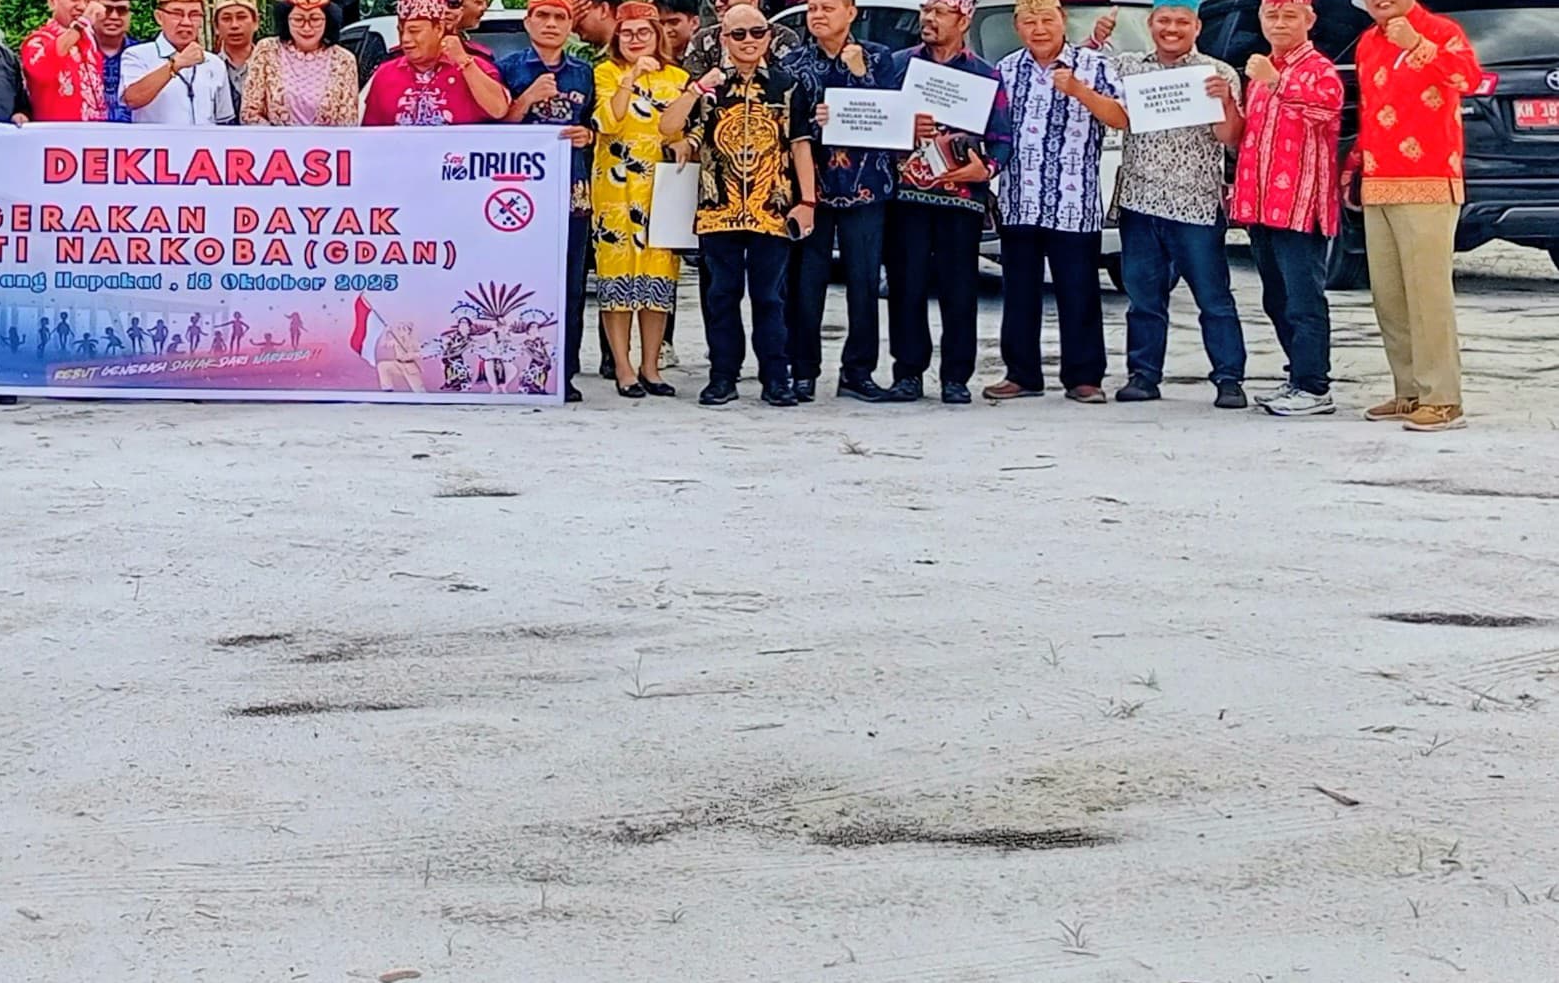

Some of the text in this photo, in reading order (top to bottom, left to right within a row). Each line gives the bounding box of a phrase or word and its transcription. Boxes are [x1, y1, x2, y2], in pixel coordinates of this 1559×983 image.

[42, 147, 352, 186] DEKLARASI
[443, 152, 465, 166] Say
[469, 152, 546, 181] DRUGS
[233, 206, 401, 235] DAYAK
[186, 272, 212, 290] 18
[221, 272, 326, 291] Oktober
[334, 273, 399, 291] 2025
[101, 361, 168, 377] GENERASI
[169, 357, 218, 373] DAYAK
[217, 354, 249, 368] DARI
